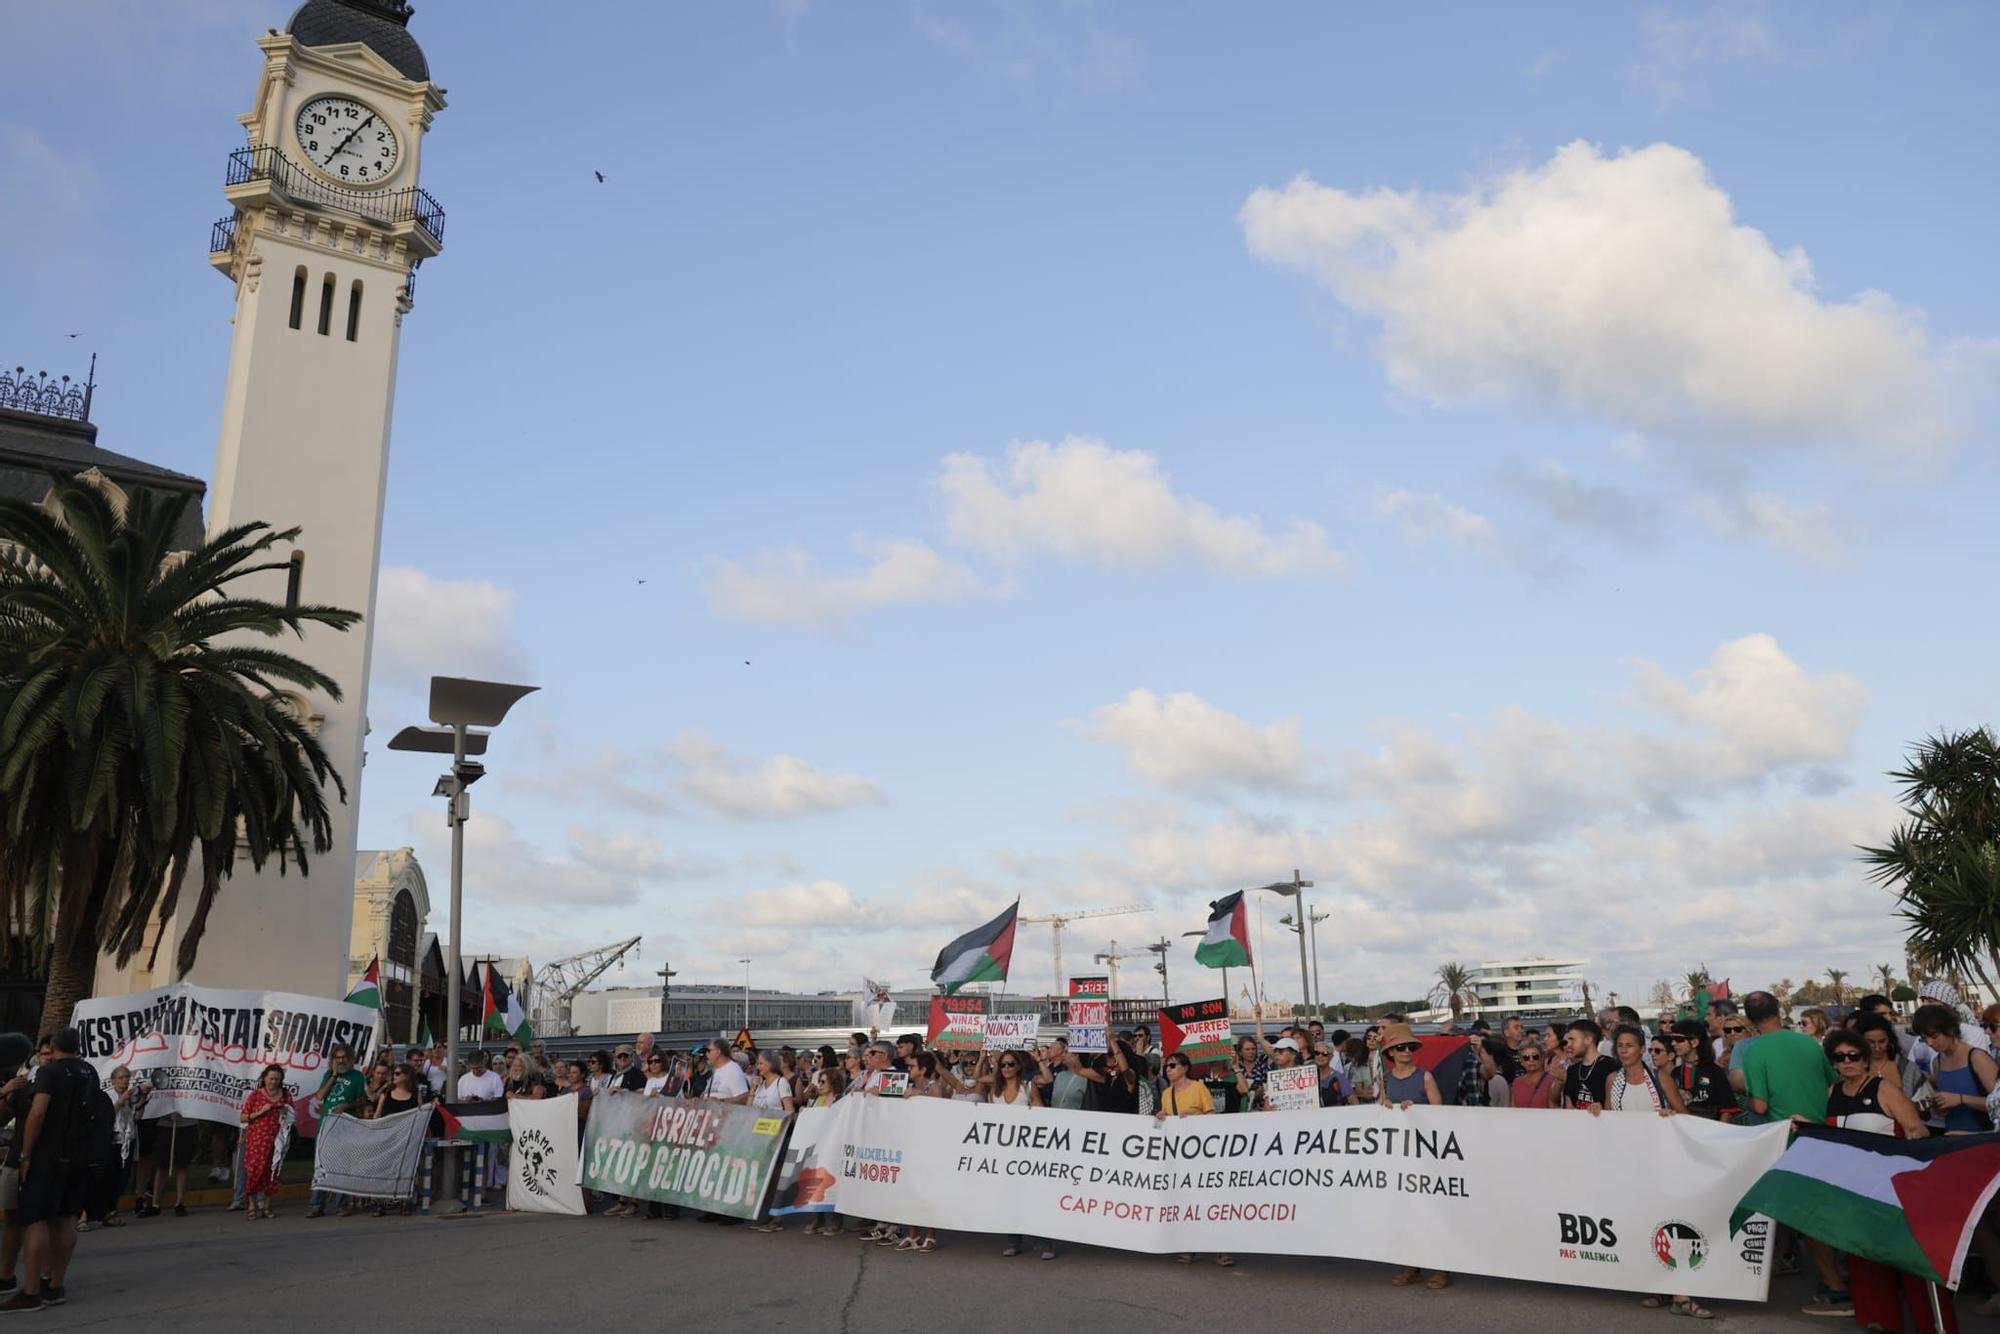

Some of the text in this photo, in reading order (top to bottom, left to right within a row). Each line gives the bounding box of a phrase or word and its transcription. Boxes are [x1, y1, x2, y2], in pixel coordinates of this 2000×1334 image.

[326, 106, 340, 119] 11
[344, 107, 359, 120] 12
[311, 113, 326, 126] 10
[304, 124, 314, 134] 9
[377, 132, 386, 142] 2
[309, 141, 318, 151] 8
[381, 147, 390, 157] 3
[341, 165, 349, 175] 6
[359, 166, 368, 176] 5
[374, 161, 382, 171] 4
[1181, 1002, 1222, 1018] NO SON
[985, 1023, 1019, 1037] NUNCA
[1185, 1020, 1228, 1034] MUERTES
[264, 1009, 374, 1065] SIONISTA
[1200, 1034, 1220, 1043] SON
[651, 1105, 720, 1148] ISRAEL:
[962, 1121, 1465, 1161] ATUREM EL GENOCIDI A PALESTINA
[588, 1136, 760, 1206] STOP GENOCIDI
[845, 1160, 901, 1183] LA MORT
[958, 1156, 972, 1172] FI
[977, 1158, 999, 1174] AL
[1006, 1160, 1083, 1185] COMERÇ
[1089, 1167, 1169, 1191] D'ARMES
[1181, 1172, 1192, 1189] A
[1198, 1171, 1224, 1189] LES
[1228, 1168, 1334, 1188] RELACIONS
[1340, 1169, 1388, 1189] AMB
[1398, 1172, 1469, 1197] ISRAEL
[1060, 1195, 1296, 1223] CAP PORT PER AL GENOCIDI
[1558, 1212, 1618, 1248] BDS
